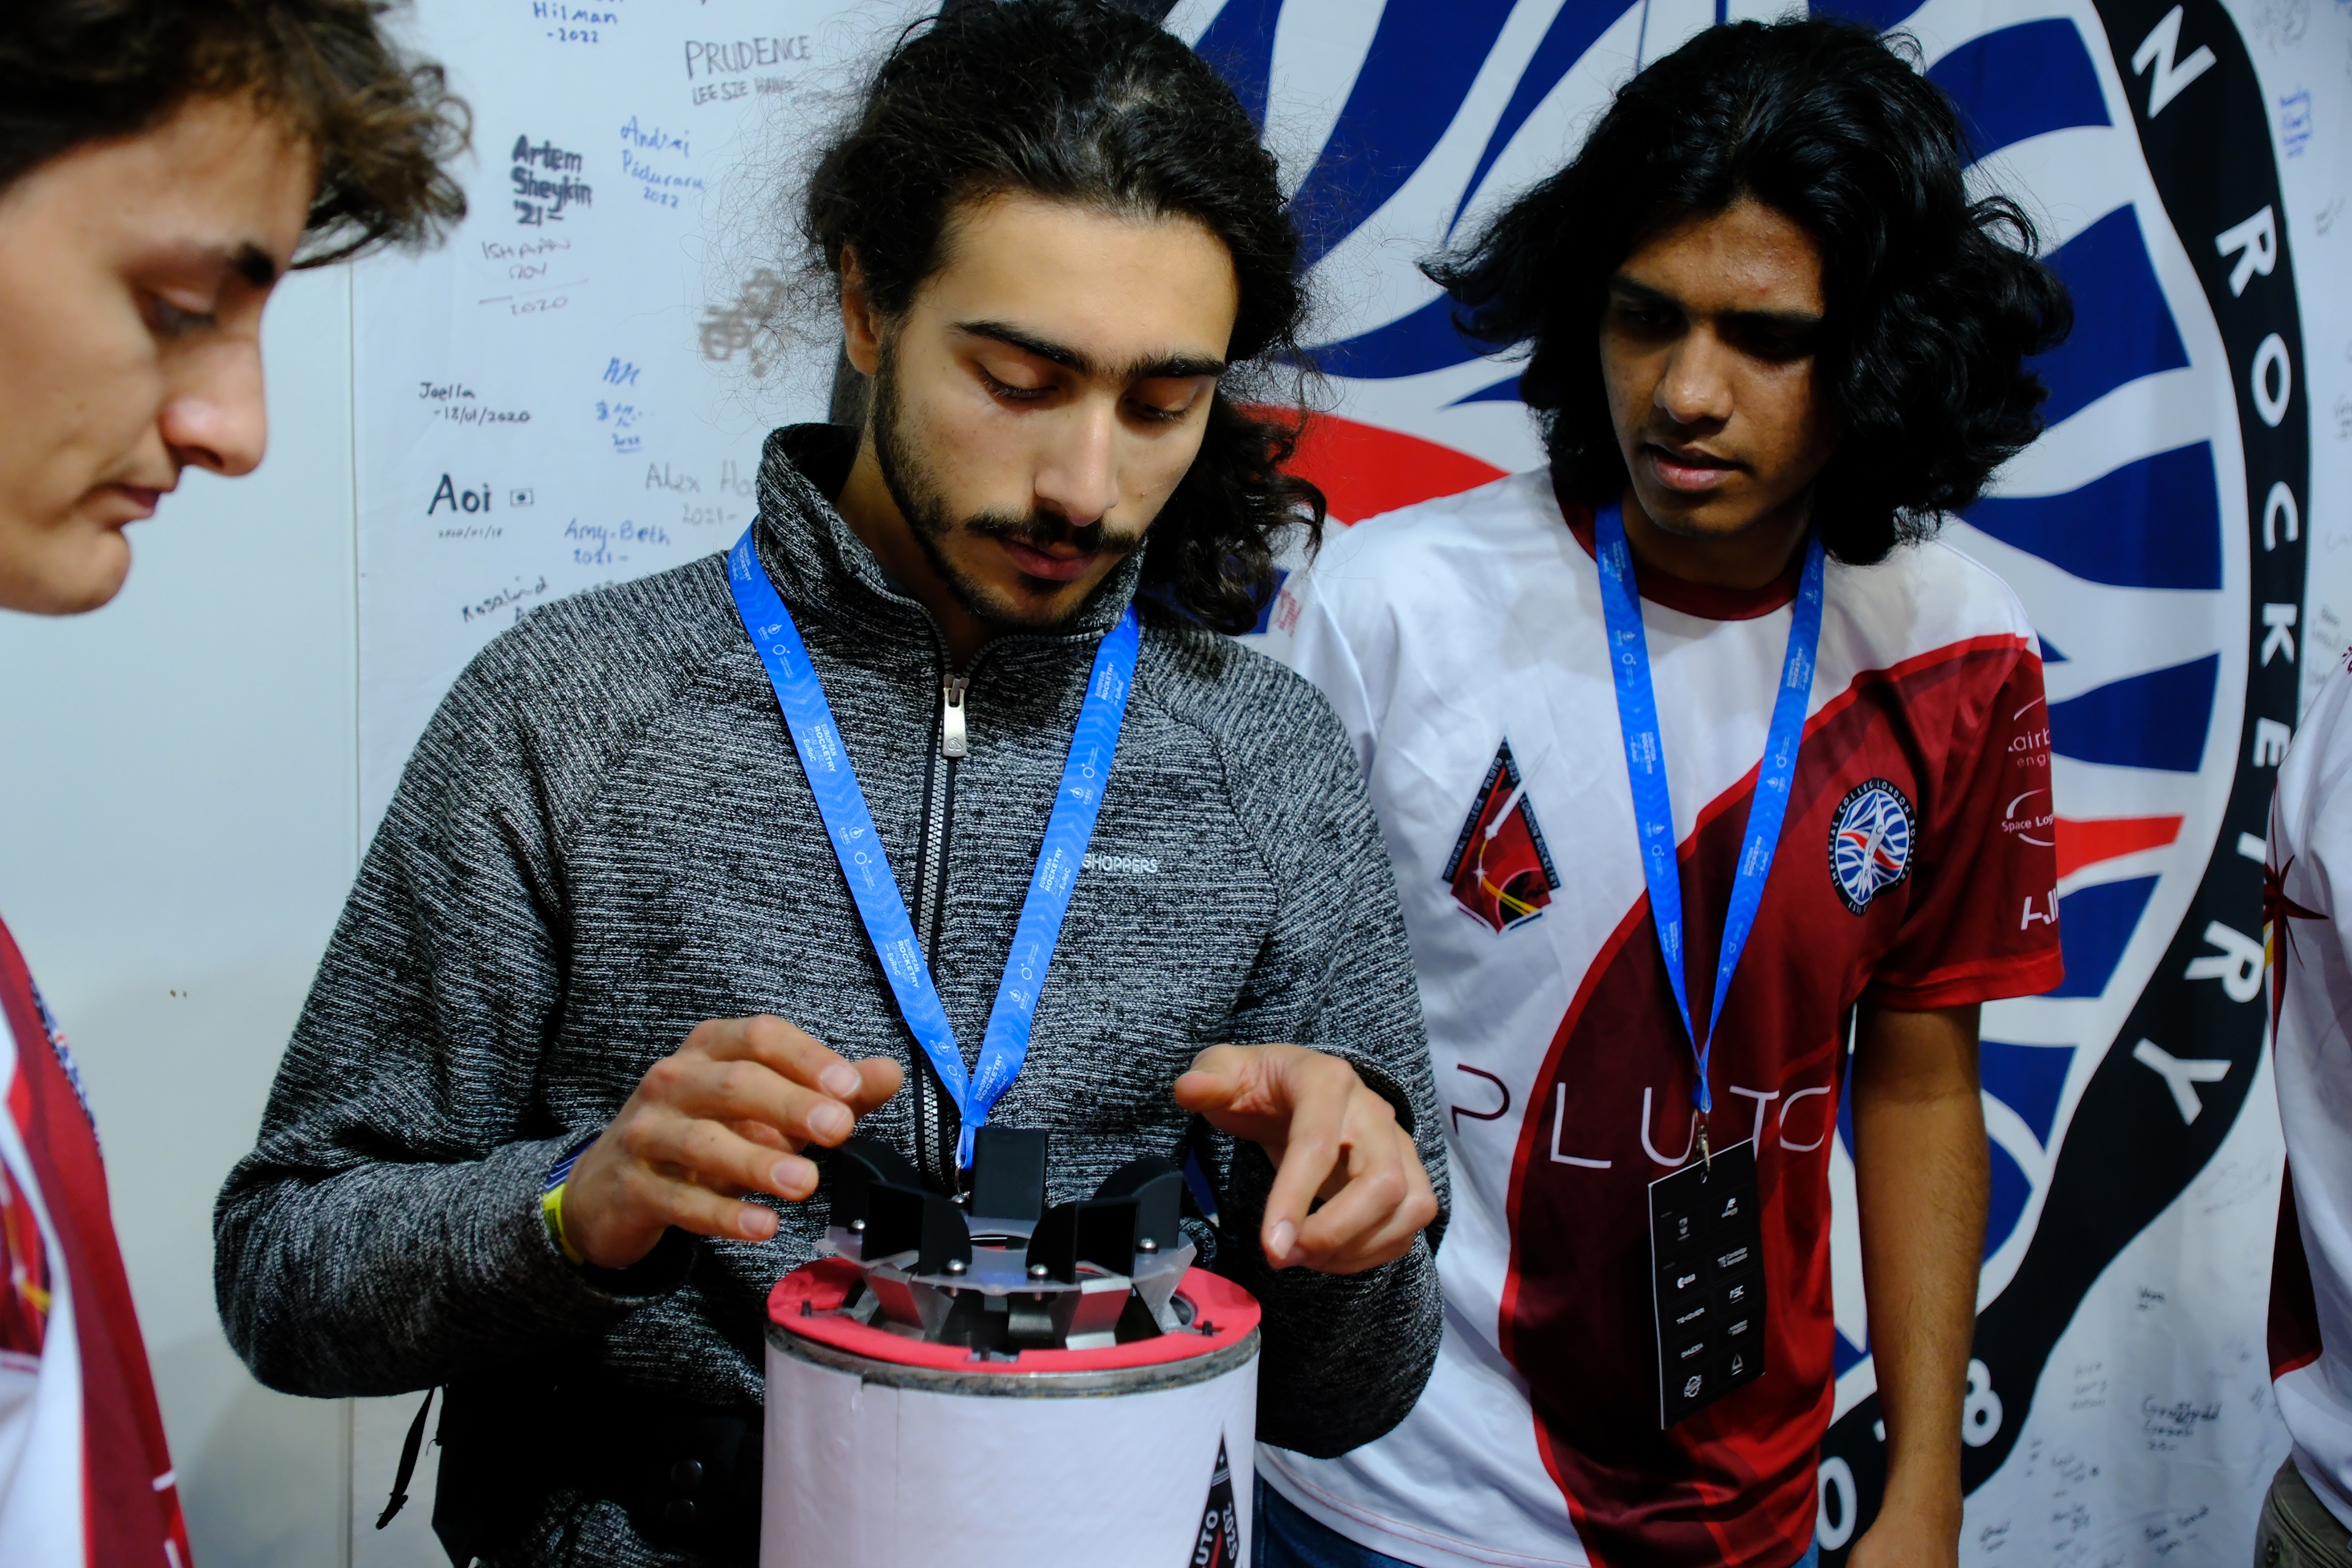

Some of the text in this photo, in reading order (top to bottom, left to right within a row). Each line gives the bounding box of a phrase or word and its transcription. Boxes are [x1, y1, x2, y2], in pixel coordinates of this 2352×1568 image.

[685, 35, 810, 80] PRUDENCE
[511, 134, 583, 173] Artem
[510, 165, 592, 213] Sheykin
[420, 381, 476, 401] Joella
[428, 472, 491, 515] Aoi
[646, 461, 701, 493] Alex
[564, 518, 671, 551] Amy-Beth
[462, 575, 548, 623] Rosalind
[1101, 662, 1115, 701] ROCKETRY
[803, 739, 817, 762] EuRoC
[814, 726, 837, 772] ROCKETRY
[821, 723, 838, 757] EUROPEAN
[1877, 780, 1912, 814] LONDON
[1828, 779, 1874, 888] IMPERIAL COLLEG
[2001, 820, 2032, 834] Space
[1039, 857, 1052, 889] EUROPEAN
[1044, 846, 1063, 892] ROCKETRY
[1060, 867, 1071, 890] EuRoC
[887, 953, 901, 976] EuRoC
[897, 940, 919, 989] ROCKETRY
[903, 938, 921, 973] EUROPEAN
[974, 1065, 992, 1100] EUROPEAN
[978, 1053, 1003, 1102] ROCKETRY
[991, 1075, 1009, 1098] EuRoC
[1195, 1509, 1219, 1568] UTO
